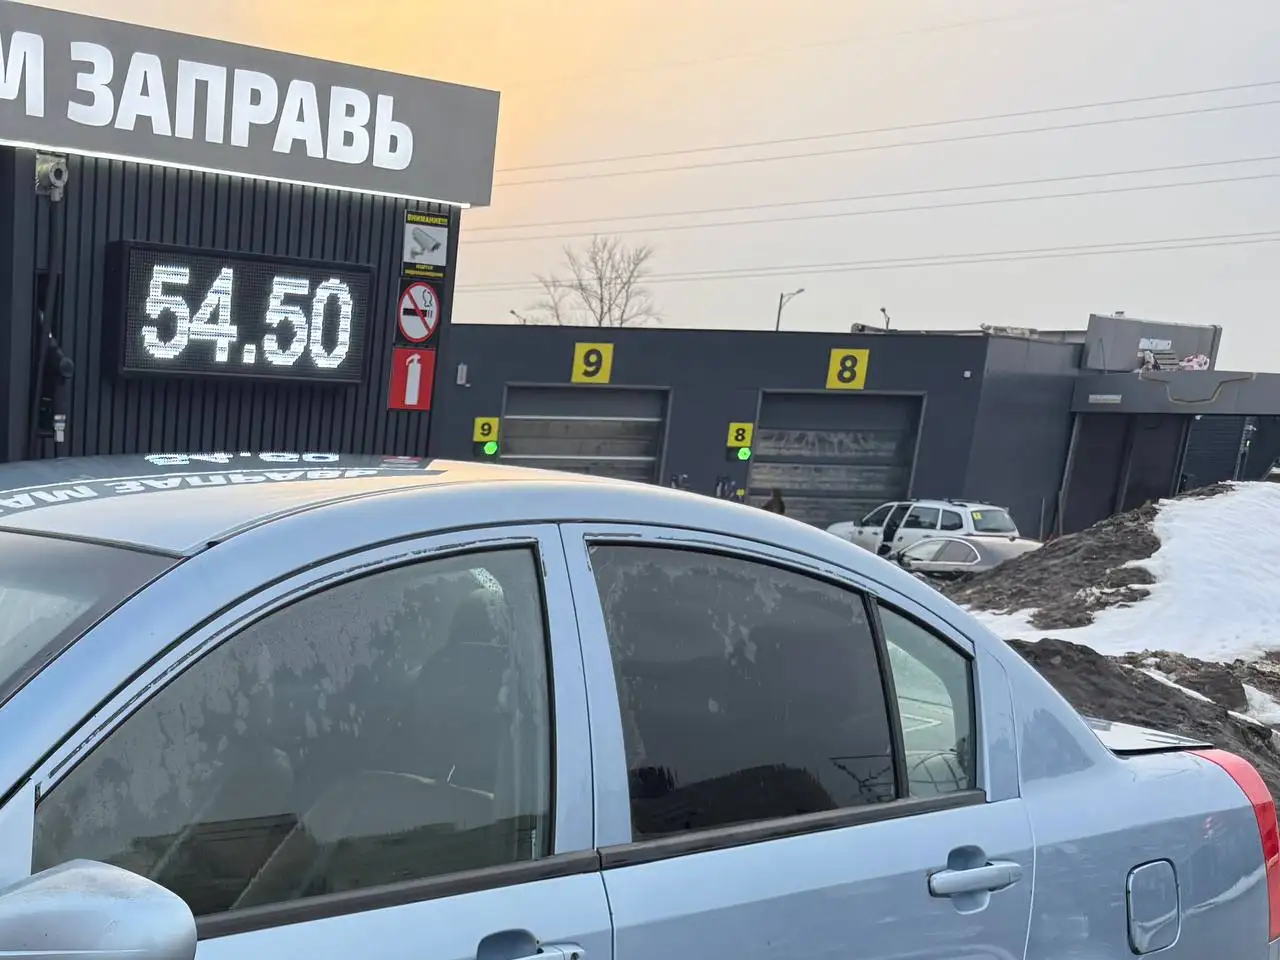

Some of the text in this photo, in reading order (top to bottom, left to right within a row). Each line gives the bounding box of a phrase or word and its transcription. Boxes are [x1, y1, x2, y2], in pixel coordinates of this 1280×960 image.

[66, 41, 414, 171] ЗАПРАВЬ
[141, 264, 353, 369] 54.50
[582, 348, 604, 378] 9
[836, 354, 858, 384] 8
[480, 422, 492, 437] 9
[734, 427, 746, 442] 8
